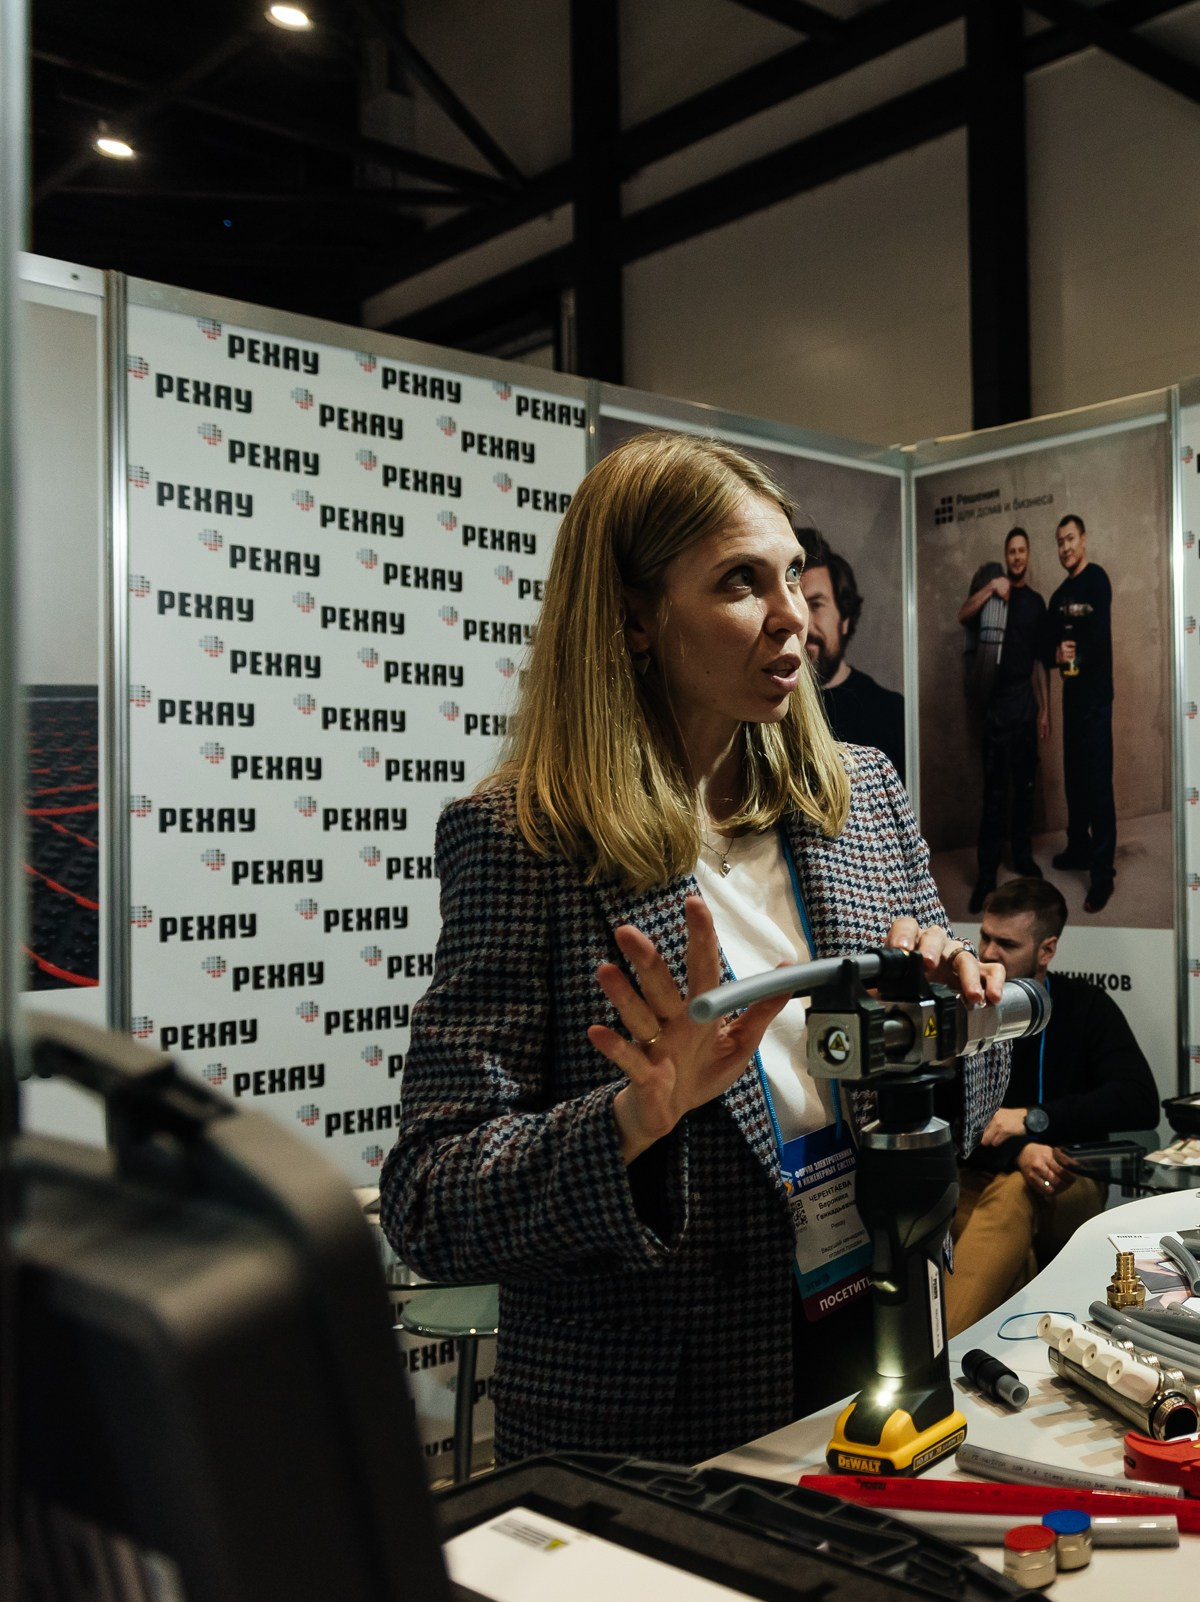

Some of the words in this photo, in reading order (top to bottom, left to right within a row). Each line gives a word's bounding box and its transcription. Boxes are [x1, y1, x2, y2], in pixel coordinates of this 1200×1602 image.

[228, 334, 319, 375] РЕХАУ
[156, 373, 252, 413] РЕХАУ
[382, 367, 461, 403] РЕХАУ
[320, 404, 403, 440] РЕХАУ
[516, 395, 585, 428] РЕХАУ
[229, 440, 319, 476] РЕХАУ
[462, 431, 535, 464] РЕХАУ
[383, 465, 461, 498] РЕХАУ
[157, 482, 252, 517] РЕХАУ
[517, 486, 570, 513] РЕХА
[321, 505, 403, 537] РЕХАУ
[463, 525, 536, 554] РЕХАУ
[230, 545, 320, 577] РЕХАУ
[384, 563, 462, 592] РЕХАУ
[158, 591, 253, 622] РЕХАУ
[322, 606, 404, 635] РЕХАУ
[463, 619, 537, 646] РЕХАУ
[231, 650, 320, 678] РЕХАУ
[385, 661, 463, 687] РЕХАУ
[159, 699, 254, 727] РЕХАУ
[322, 707, 405, 732] РЕХАУ
[232, 756, 321, 780] РЕХАУ
[386, 759, 464, 782] РЕХАУ
[160, 808, 255, 832] РЕХАУ
[323, 808, 406, 831] РЕХАУ
[232, 859, 322, 885] РЕХАУ
[386, 856, 439, 879] РЕХ
[160, 914, 256, 942] РЕХАУ
[324, 906, 407, 933] РЕХАУ
[233, 961, 323, 991] РЕХАУ
[325, 1004, 408, 1035] РЕХАУ
[161, 1019, 257, 1051] РЕХАУ
[234, 1064, 324, 1097] РЕХАУ
